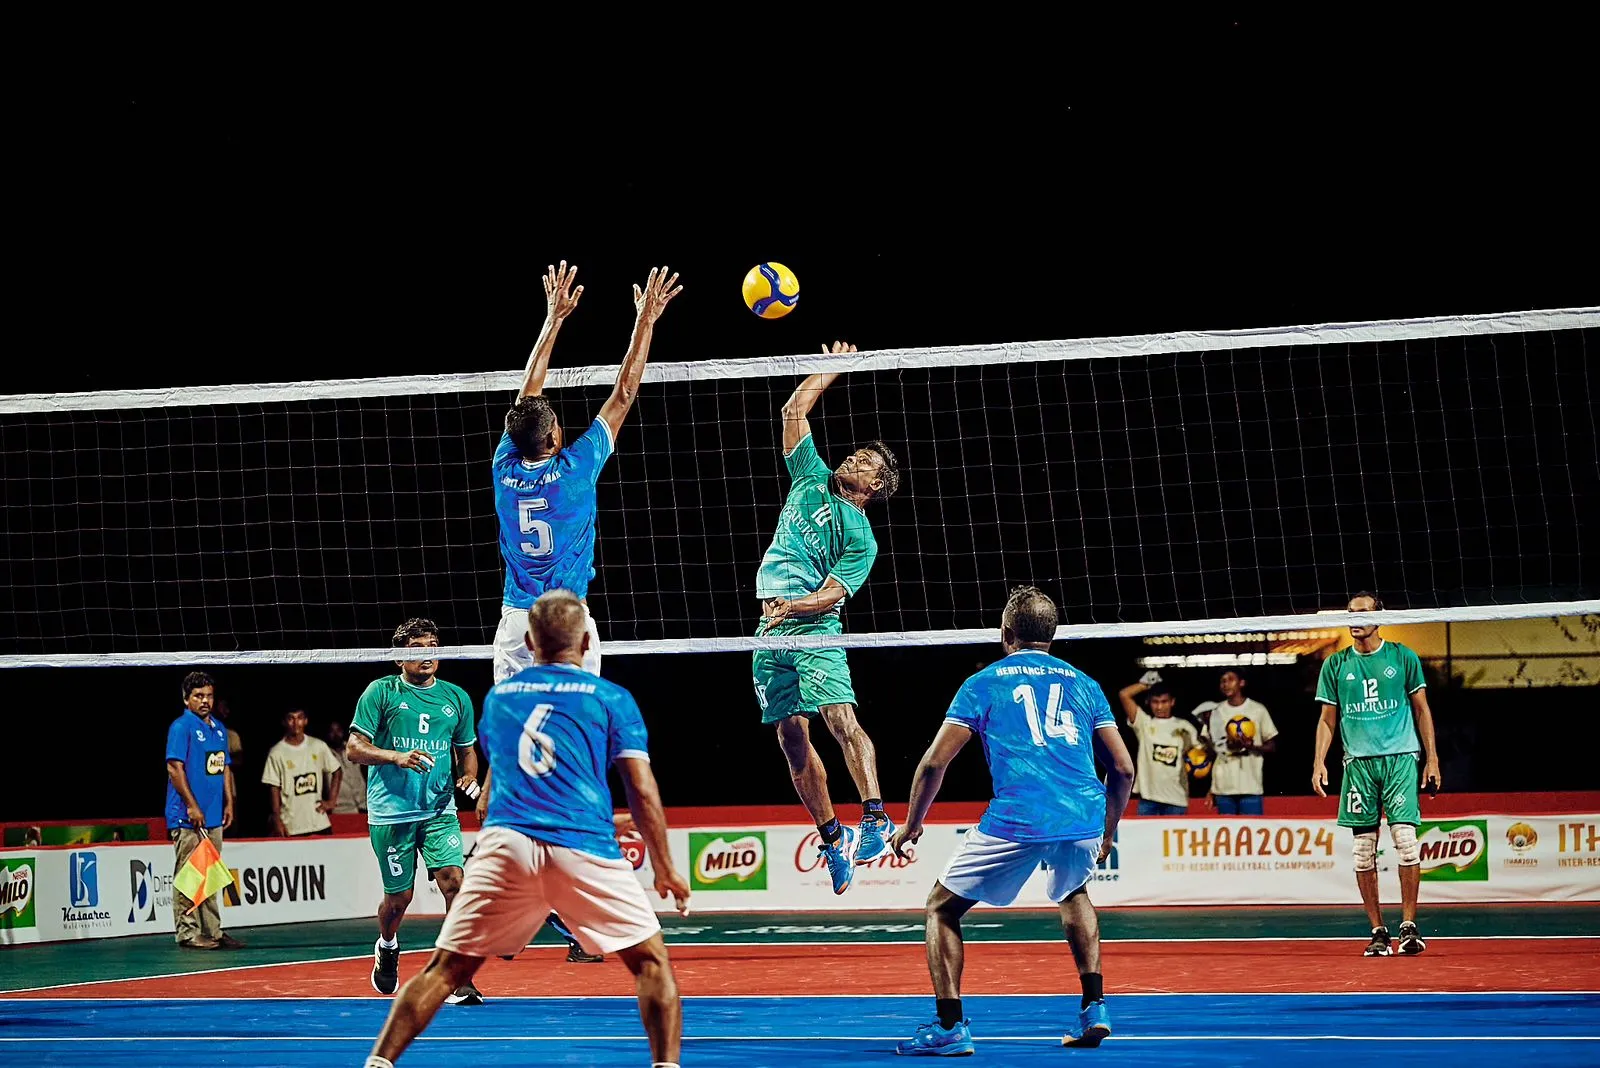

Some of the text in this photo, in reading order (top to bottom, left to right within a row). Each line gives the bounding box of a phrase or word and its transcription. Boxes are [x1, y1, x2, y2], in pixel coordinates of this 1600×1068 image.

[810, 503, 832, 528] 10
[518, 498, 553, 557] 5
[1362, 678, 1379, 698] 12
[1012, 683, 1078, 746] 14
[1345, 699, 1398, 714] EMERALD
[418, 713, 430, 734] 6
[393, 736, 448, 754] EMERALD
[518, 703, 557, 779] 6
[1347, 792, 1362, 814] 12
[1162, 826, 1334, 858] ITHAA2024
[1420, 839, 1477, 862] MILO
[387, 854, 403, 877] 6
[705, 850, 756, 872] MILO
[1222, 862, 1272, 872] VOLLEYBALL
[1274, 860, 1335, 871] CHAMPIONSHIP
[154, 875, 173, 893] DIFF
[243, 864, 326, 905] SIOVIN
